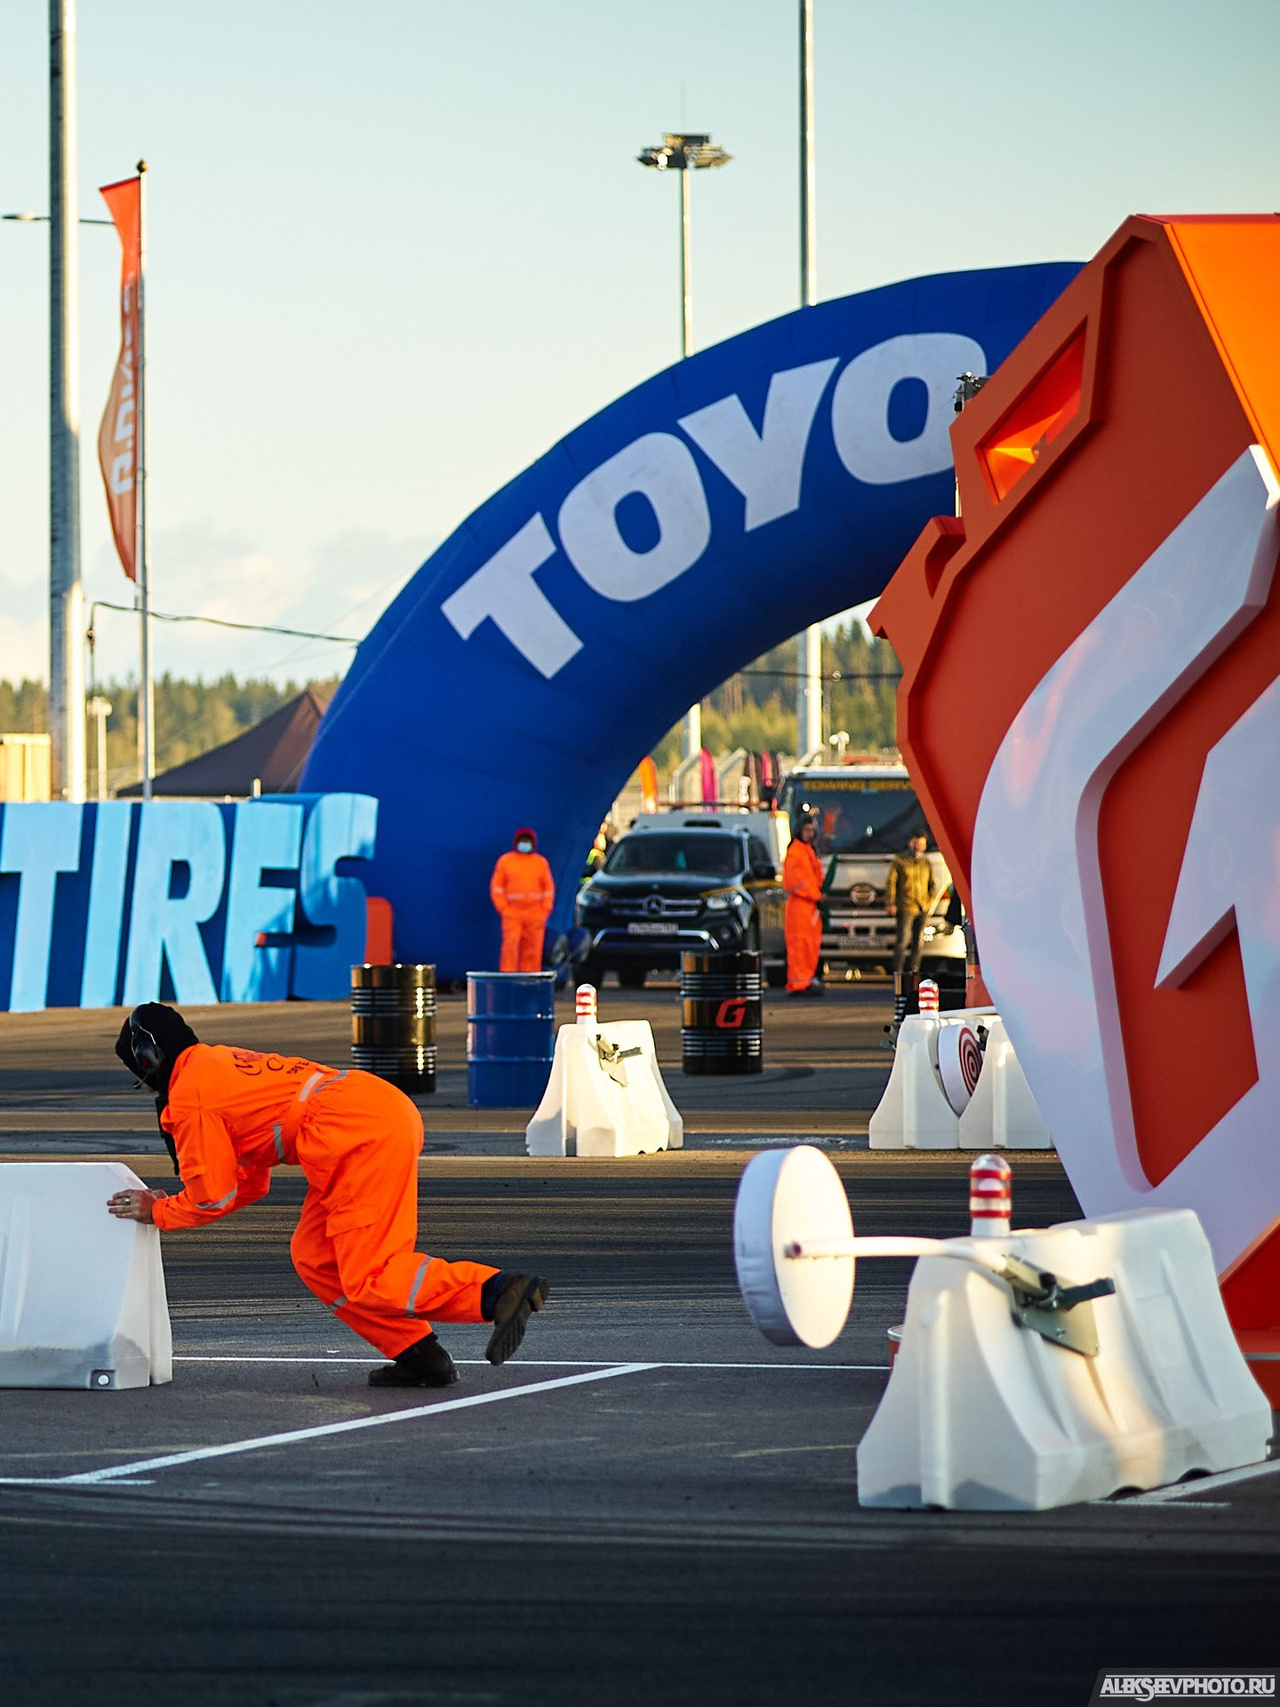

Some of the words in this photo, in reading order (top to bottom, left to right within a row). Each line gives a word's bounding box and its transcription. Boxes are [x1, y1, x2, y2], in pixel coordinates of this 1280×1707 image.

[440, 332, 987, 680] TOYO
[0, 793, 379, 1012] TIRES
[716, 997, 748, 1028] G
